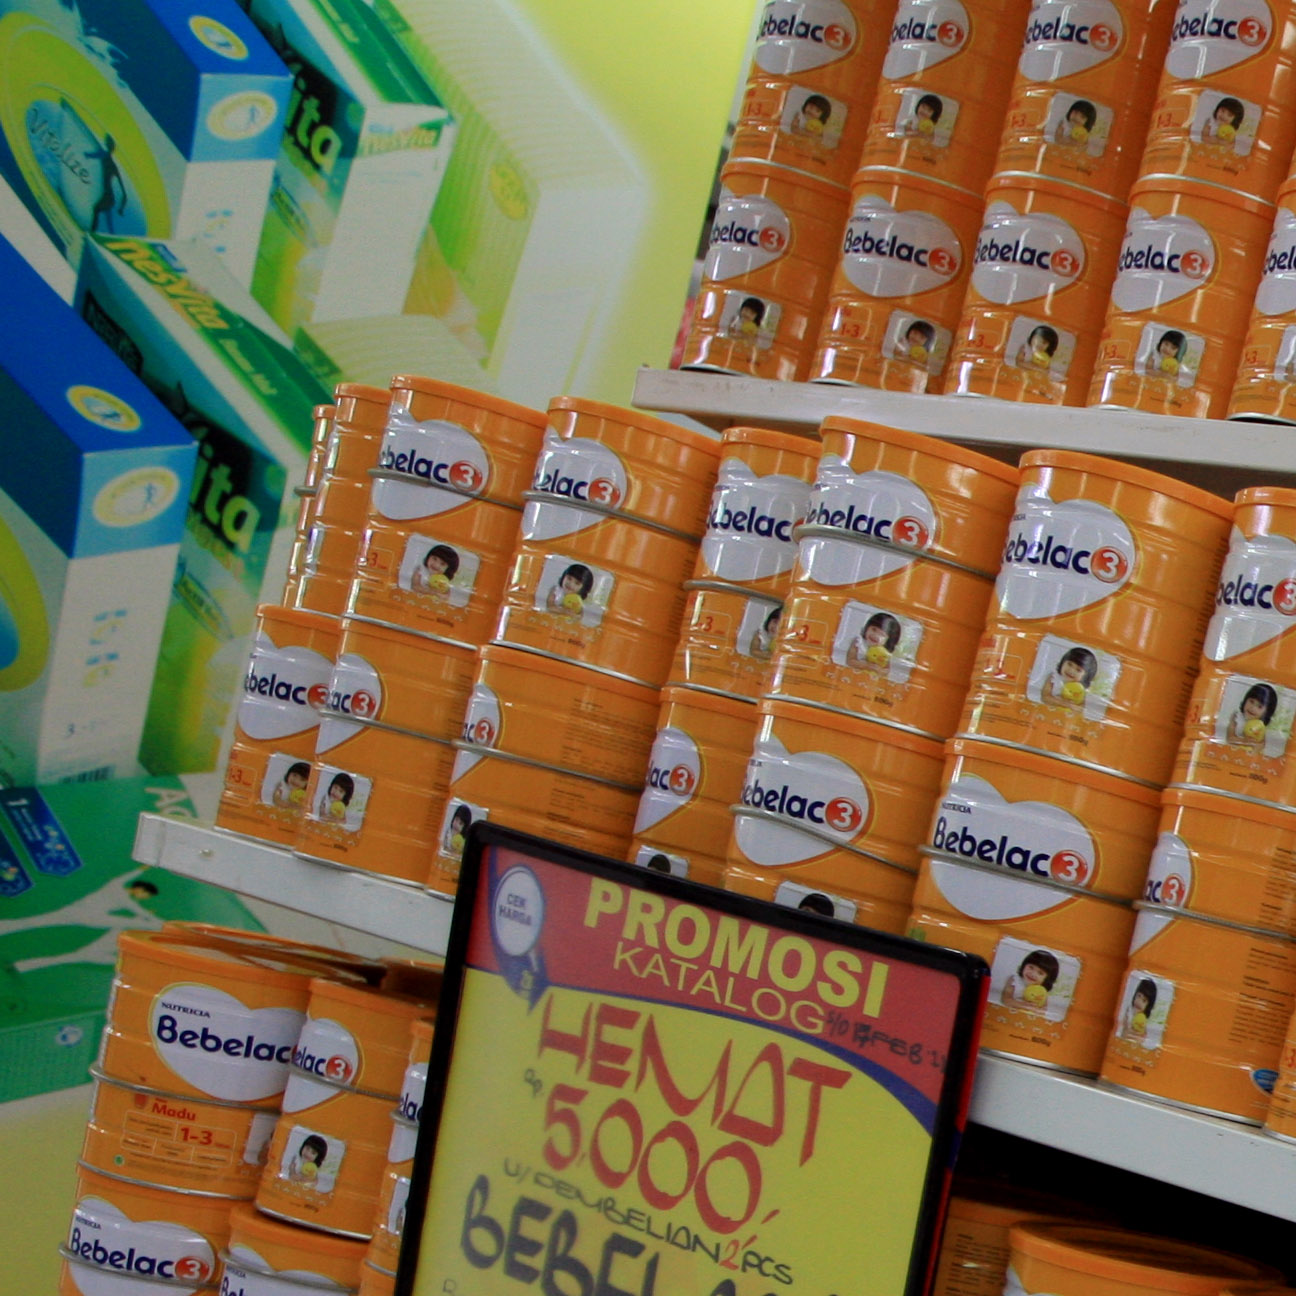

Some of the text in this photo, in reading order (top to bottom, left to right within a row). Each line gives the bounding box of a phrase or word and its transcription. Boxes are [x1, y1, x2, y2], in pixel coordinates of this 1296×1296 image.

[584, 876, 889, 1018] PROMOSI
[613, 940, 827, 1034] KATALOG
[537, 993, 853, 1168] HEMAT
[741, 1251, 794, 1286] PCS
